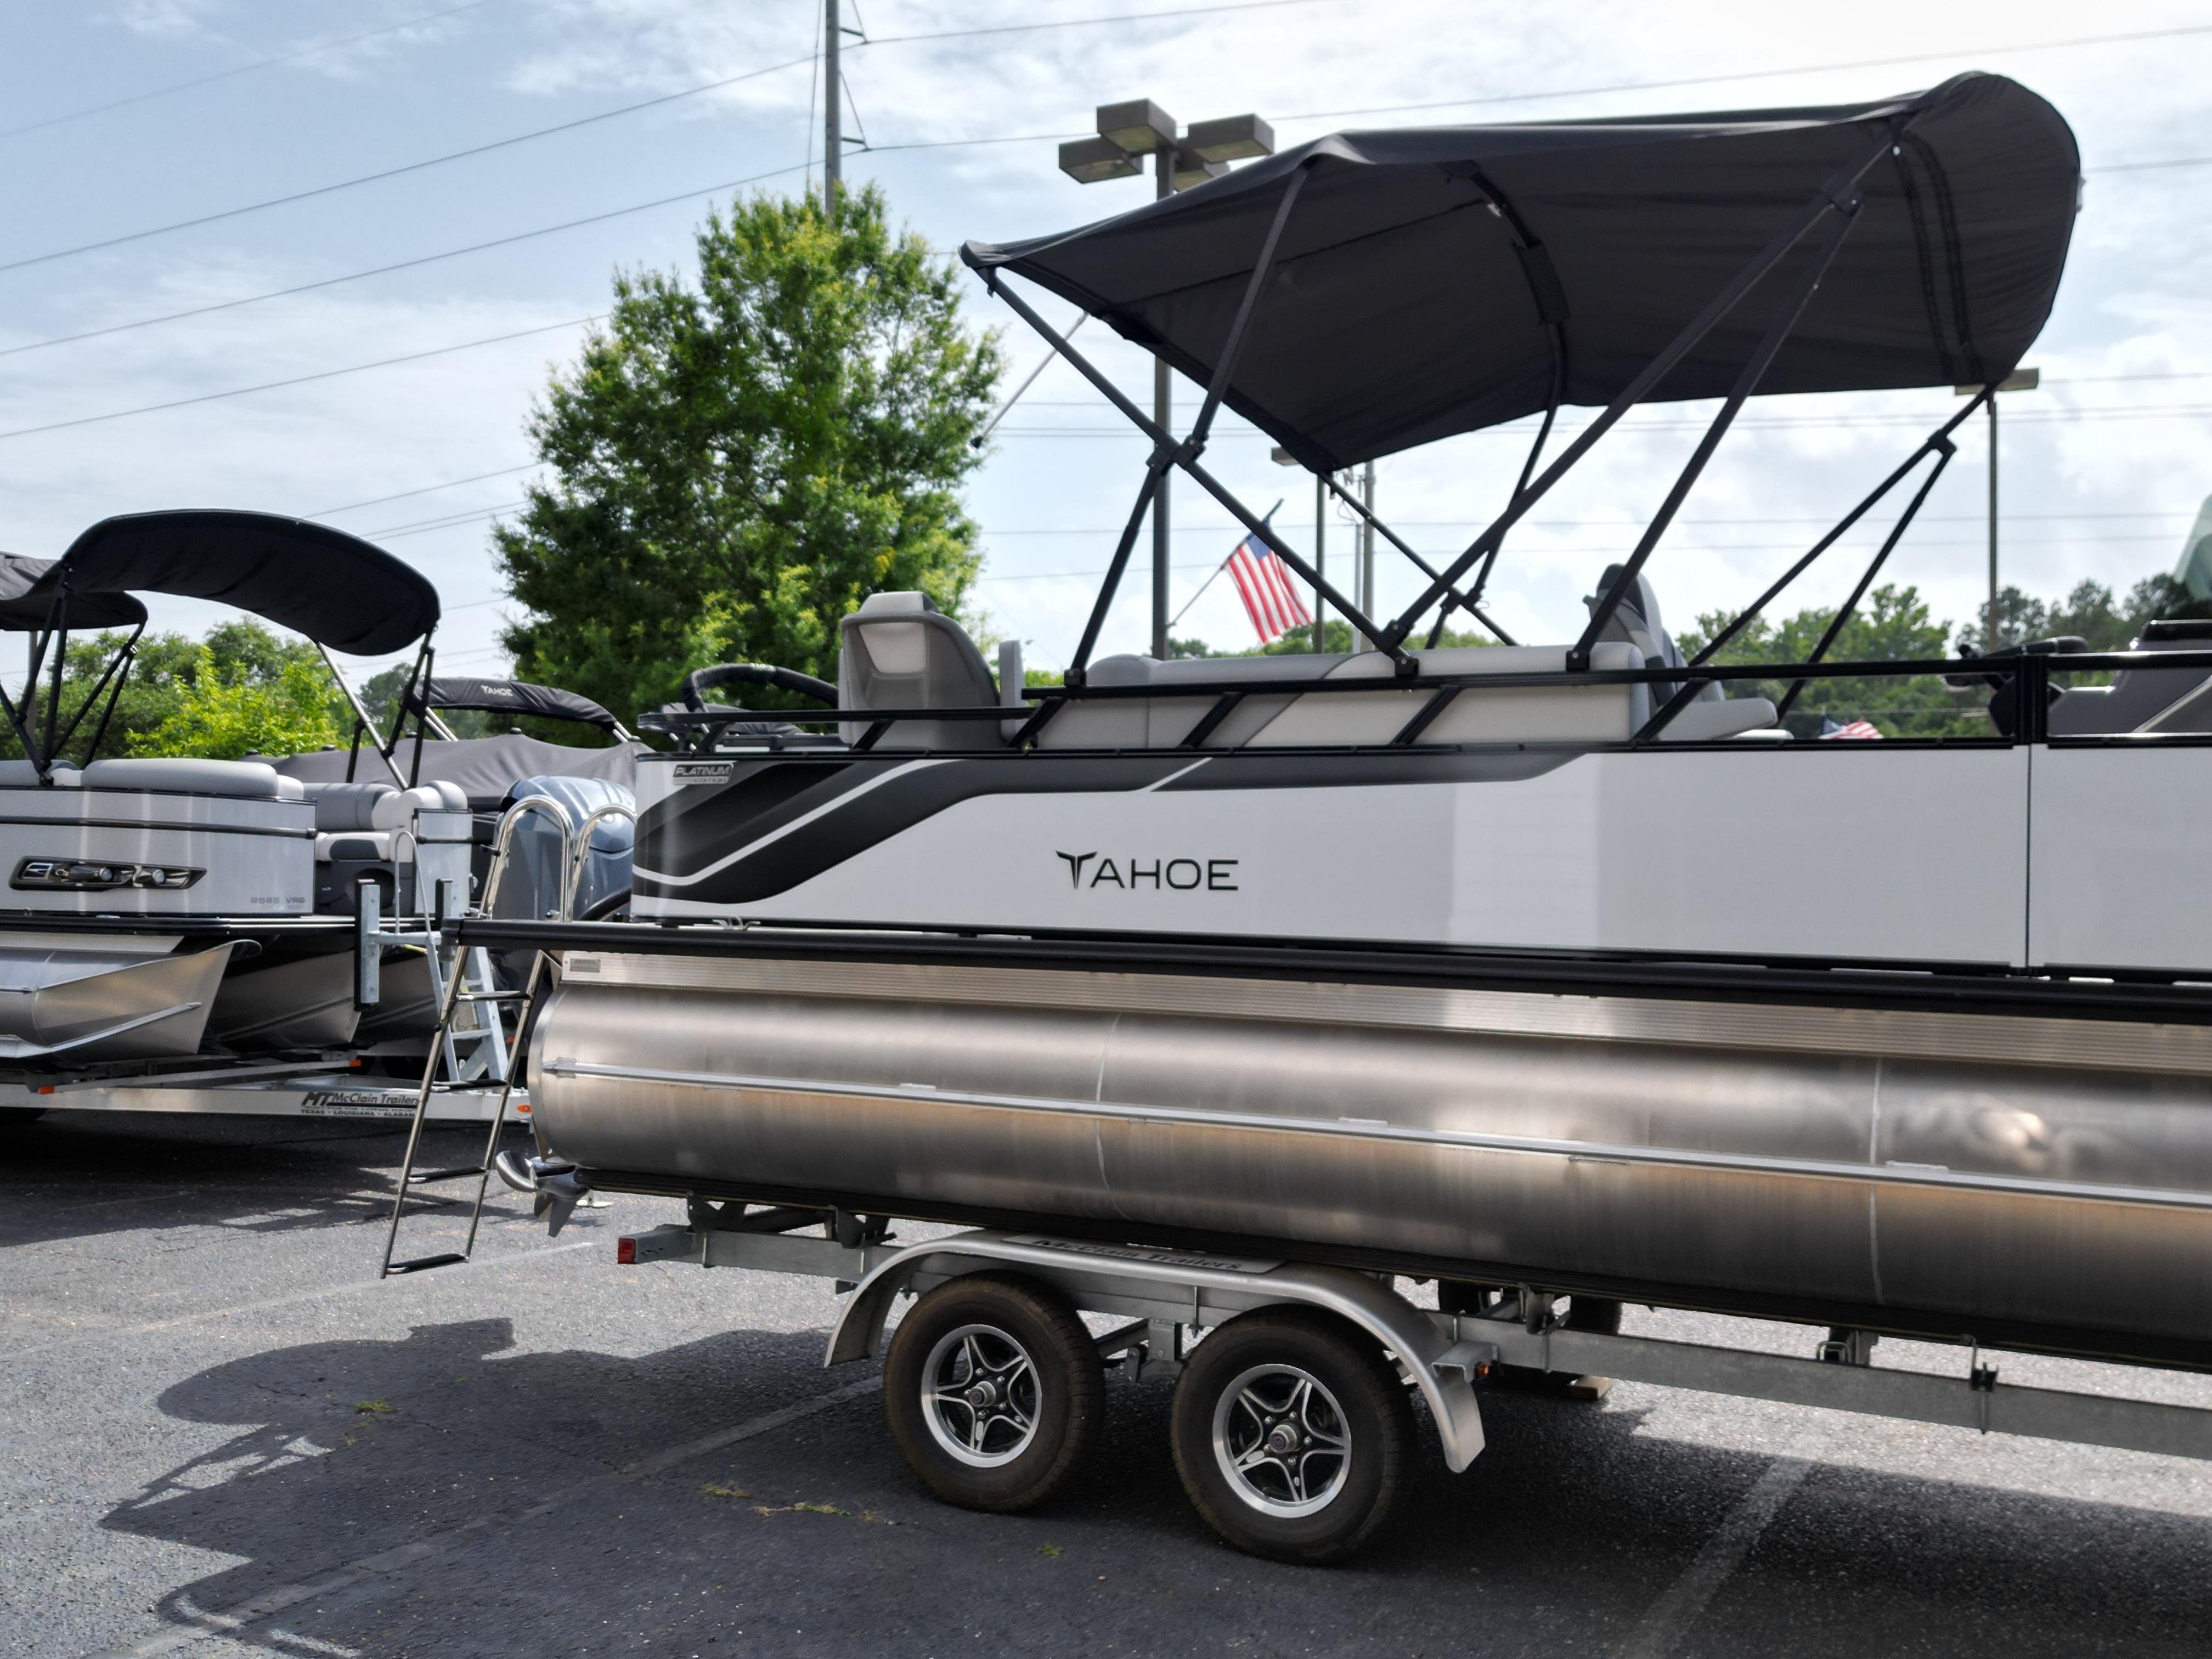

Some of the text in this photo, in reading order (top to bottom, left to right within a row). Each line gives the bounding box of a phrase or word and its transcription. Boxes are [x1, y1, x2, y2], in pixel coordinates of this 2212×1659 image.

[481, 684, 514, 697] TAHOE
[675, 766, 730, 776] PLATINUM
[1056, 850, 1239, 890] TAHOE
[332, 1093, 377, 1103] McClain
[381, 1094, 420, 1104] Trailers
[1032, 1239, 1242, 1269] McClain Trailers
